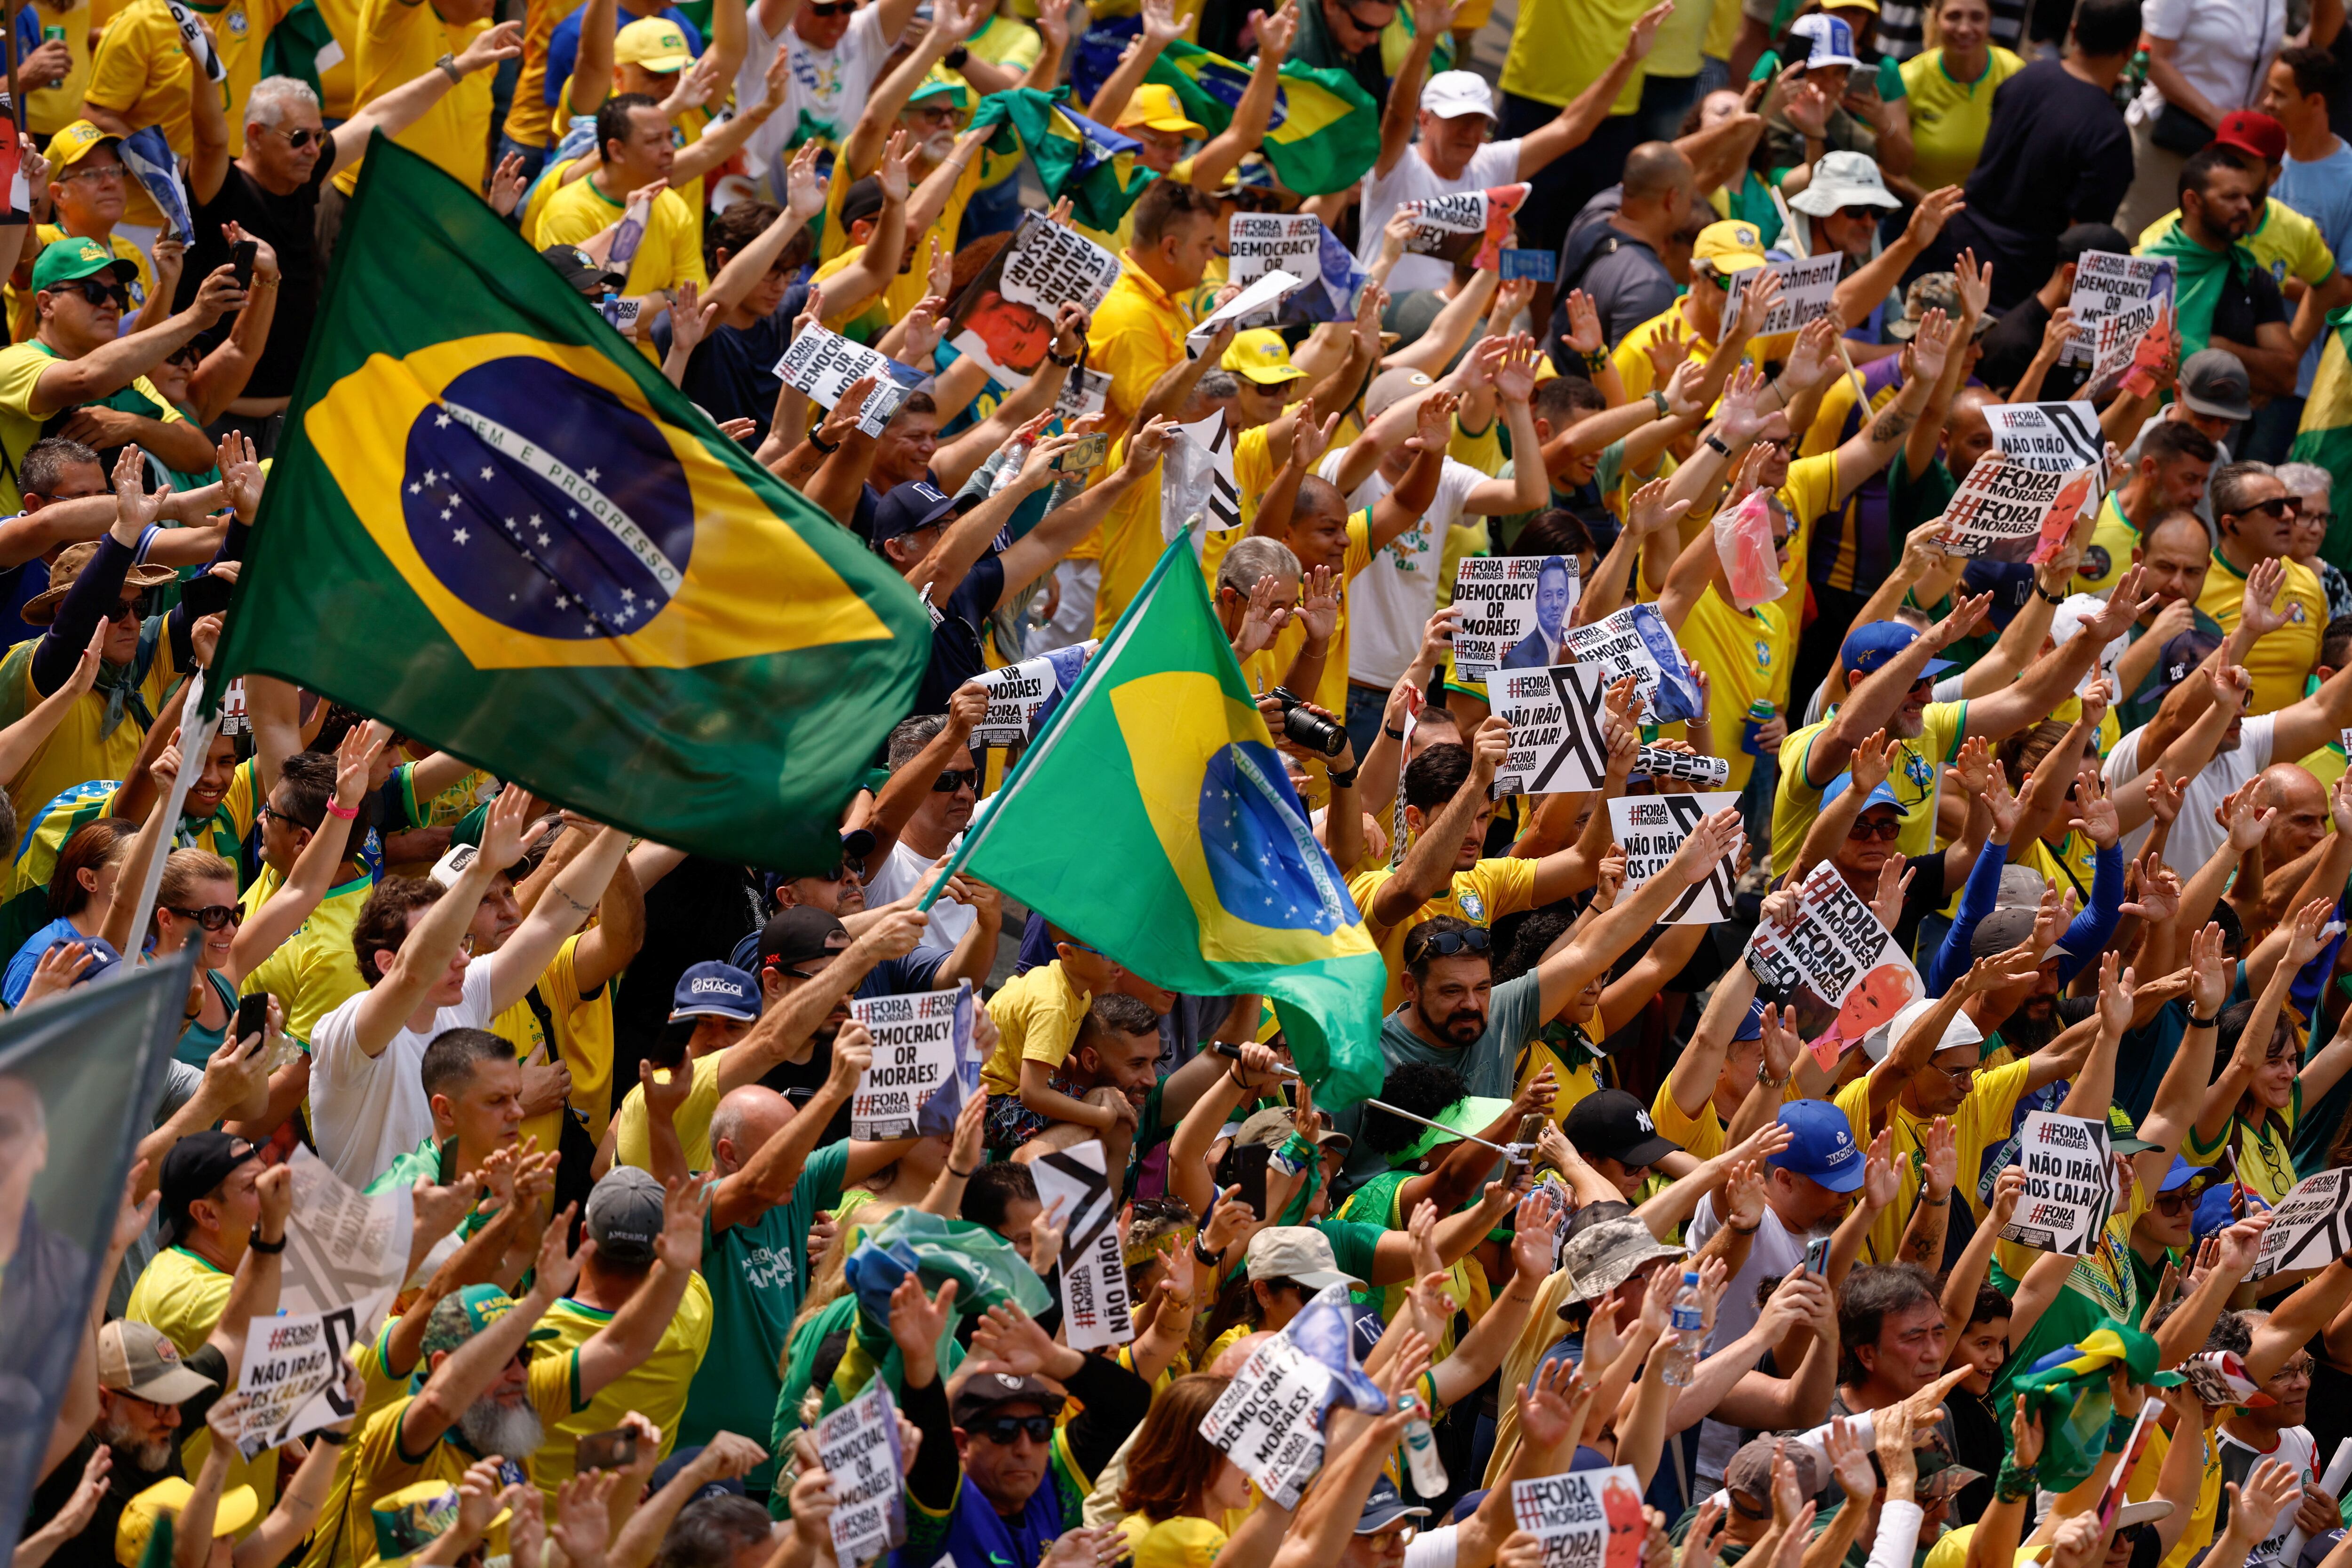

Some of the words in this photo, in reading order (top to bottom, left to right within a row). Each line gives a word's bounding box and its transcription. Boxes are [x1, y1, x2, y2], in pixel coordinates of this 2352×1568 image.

[1425, 207, 1481, 229] MORAES
[1231, 239, 1316, 257] DEMOCRACY
[1026, 232, 1074, 293] VAMOS
[1265, 258, 1282, 272] OR
[1733, 259, 1836, 298] Imchment
[2080, 274, 2149, 298] DEMOCRACY
[2105, 297, 2122, 311] OR
[795, 334, 848, 395] DEMOCRA
[832, 351, 854, 373] OR
[2002, 411, 2044, 428] #FORA
[2001, 434, 2030, 454] NÃO
[2034, 434, 2065, 454] IRÃO
[1966, 464, 2062, 491] #FORA
[1988, 483, 2057, 502] MORAES
[520, 444, 535, 463] E
[548, 463, 675, 582] PROGRESSO
[1947, 494, 2042, 525] #FORA
[1969, 516, 2037, 534] MORAES
[1460, 560, 1503, 579] #FORA
[1455, 583, 1535, 601] DEMOCRACY
[1486, 602, 1505, 618] OR
[1462, 618, 1520, 636] MORAES!
[1567, 626, 1604, 651] #FORA
[1576, 633, 1643, 663] DEMOCRACY
[1581, 632, 1610, 648] MORAES
[1454, 640, 1496, 660] #FORA
[1464, 652, 1495, 660] MORAES
[999, 666, 1022, 681] OR
[1614, 655, 1633, 671] OR
[2169, 665, 2184, 681] 28
[986, 678, 1042, 701] MORAES!
[1506, 675, 1550, 699] #FORA
[1521, 688, 1550, 698] MORAES
[982, 716, 1022, 726] MORAES
[984, 704, 1022, 718] FORA
[1501, 705, 1530, 728] NÃO
[1531, 702, 1562, 726] IRÃO
[1518, 727, 1562, 747] CALAR!
[1232, 746, 1281, 804] ORDEM
[1507, 762, 1536, 773] MORAES
[1628, 804, 1668, 826] #FORA
[1640, 816, 1669, 826] MORAES
[1623, 832, 1650, 856] NÃO
[1627, 860, 1645, 878] OS
[1803, 869, 1889, 959] #FORA
[1816, 902, 1876, 970] MORAES
[1769, 911, 1856, 991] #FORA
[1785, 935, 1841, 1003] MORAES
[702, 982, 742, 995] MAGGI
[855, 999, 913, 1024] #FORA
[918, 993, 956, 1020] #FOR
[871, 1012, 914, 1024] MORAES
[871, 1021, 951, 1046] EMOCRACY
[895, 1046, 917, 1065] OR
[869, 1063, 938, 1088] MORAES!
[854, 1092, 910, 1117] #FORA
[870, 1104, 910, 1117] MORAES
[2037, 1122, 2088, 1144] #FORA
[2050, 1138, 2088, 1151] MORAES
[1980, 1146, 2013, 1190] ORDEM
[2012, 1137, 2021, 1148] E
[2028, 1151, 2062, 1177] NÃO
[2020, 1177, 2050, 1199] NOS
[2298, 1174, 2340, 1195] #FORA
[2307, 1183, 2335, 1195] MORAES
[2028, 1203, 2075, 1225] #FORA
[2273, 1199, 2303, 1217] NÃO
[2277, 1211, 2322, 1227] CALAR!
[2039, 1216, 2074, 1231] MORAES
[607, 1230, 648, 1243] AMERICA
[2259, 1229, 2290, 1258] #FORA
[1096, 1235, 1123, 1285] IRÃO
[1070, 1268, 1097, 1329] #FORA
[1082, 1264, 1095, 1311] MORAES
[1104, 1288, 1129, 1333] NÃO
[251, 1358, 286, 1386] NÃO
[1258, 1399, 1283, 1427] OR
[1255, 1386, 1314, 1464] MORAES!
[822, 1422, 885, 1473] DEMOCRAC
[1518, 1475, 1596, 1529] #FORA
[1541, 1503, 1602, 1527] MORAES
